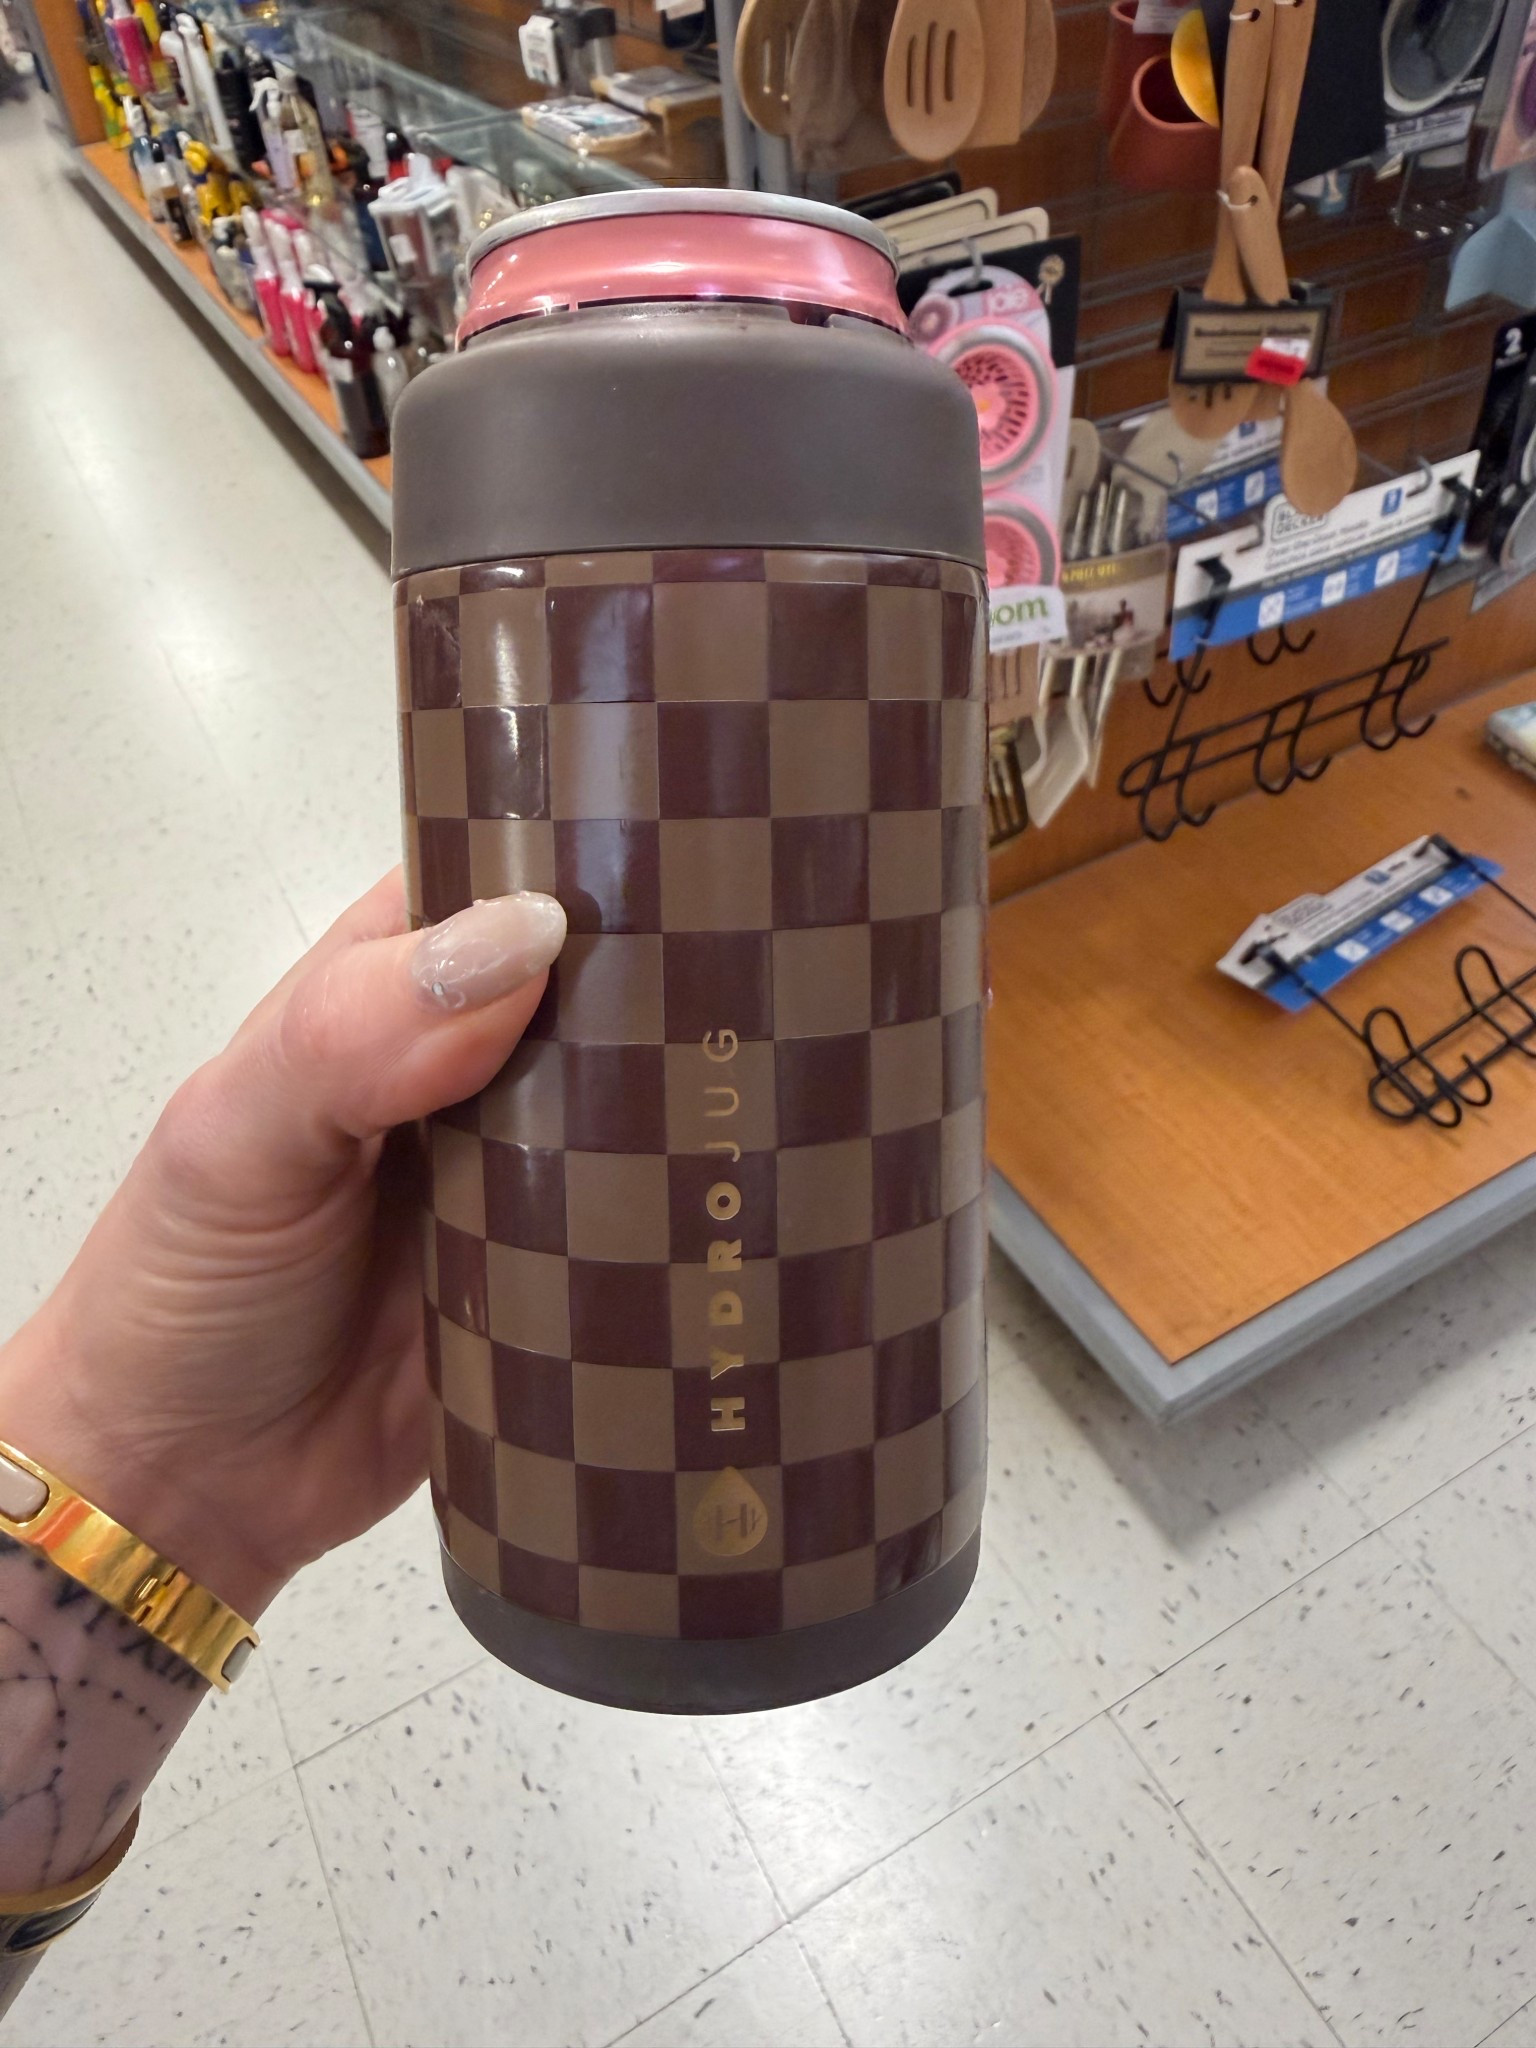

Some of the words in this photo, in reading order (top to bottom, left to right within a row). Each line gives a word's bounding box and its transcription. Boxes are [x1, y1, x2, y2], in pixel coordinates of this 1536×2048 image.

[1505, 327, 1522, 356] 2
[990, 597, 1048, 627] om
[702, 1028, 746, 1432] HYDROJUG
